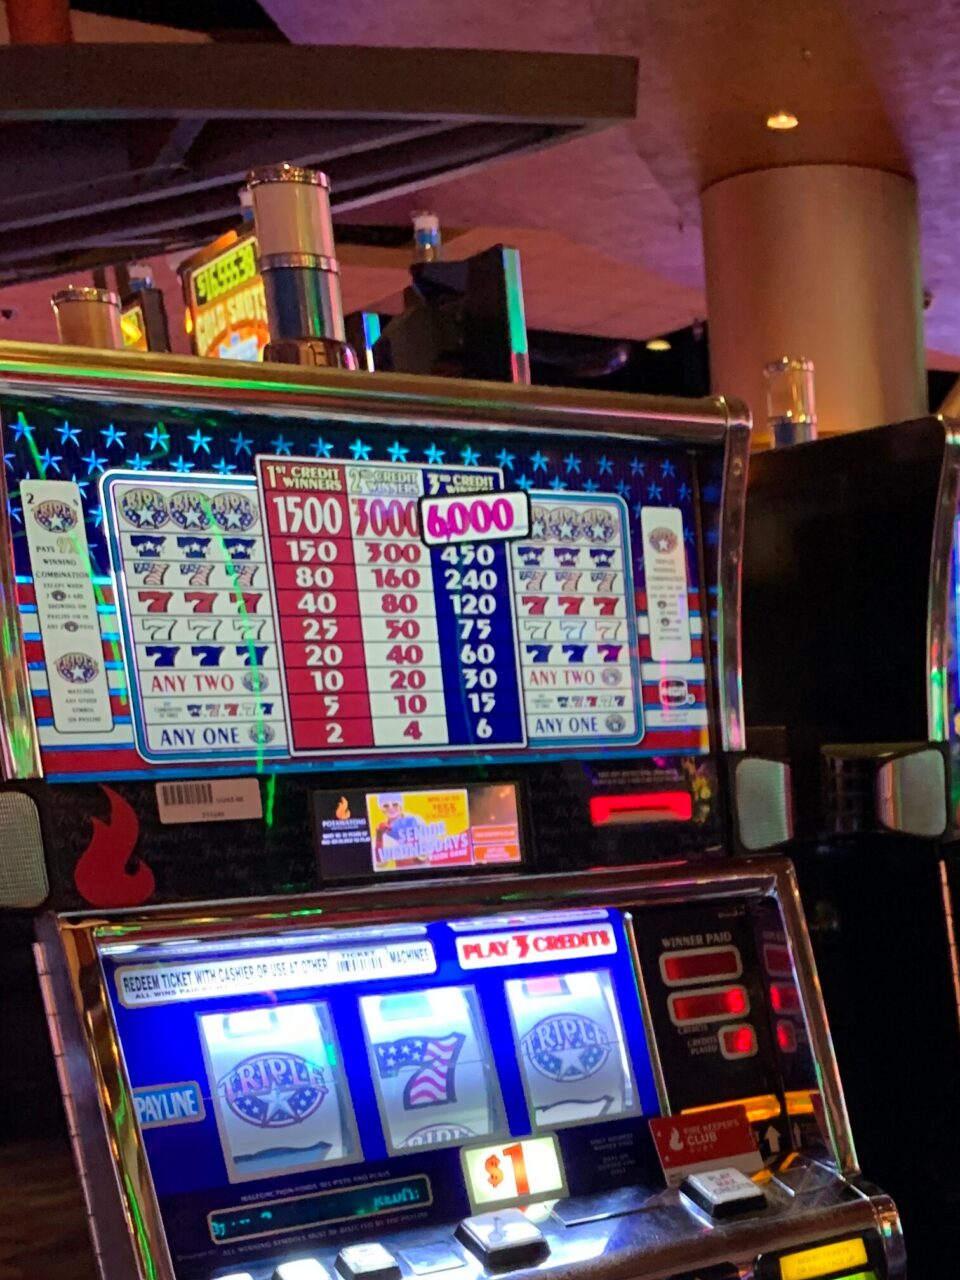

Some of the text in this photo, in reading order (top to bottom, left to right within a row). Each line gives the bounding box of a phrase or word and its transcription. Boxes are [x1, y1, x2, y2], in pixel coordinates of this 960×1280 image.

[291, 467, 339, 479] CREDIT
[373, 471, 418, 483] CREDIT
[452, 474, 494, 488] CREDIT
[283, 477, 342, 491] WINNERS
[273, 496, 342, 534] 1500
[352, 498, 421, 538] 3000
[287, 541, 338, 562] 150
[365, 543, 421, 563] 300
[441, 545, 495, 565] 450
[43, 558, 77, 566] WINNING
[296, 567, 334, 588] 80
[371, 568, 420, 589] 160
[444, 569, 498, 590] 240
[297, 592, 337, 613] 40
[381, 593, 420, 614] 80
[449, 594, 497, 614] 120
[302, 619, 338, 640] 25
[385, 619, 420, 639] 50
[458, 619, 492, 639] 75
[305, 645, 343, 666] 20
[386, 644, 424, 665] 40
[460, 644, 495, 665] 60
[151, 674, 235, 693] ANY TWO
[310, 670, 344, 692] 10
[390, 670, 426, 690] 20
[462, 669, 497, 690] 30
[529, 669, 595, 686] ANY TWO
[323, 695, 339, 717] 5
[394, 694, 427, 714] 10
[468, 693, 496, 713] 15
[326, 723, 344, 744] 2
[403, 721, 423, 740] 4
[476, 718, 493, 738] 6
[535, 716, 599, 733] ANY ONE
[161, 727, 241, 746] ANY ONE
[462, 929, 611, 961] PLAY 3 CREDITS
[661, 931, 732, 948] WINNER PAID
[389, 948, 429, 963] MACHINES
[123, 974, 160, 992] REDEEM
[161, 971, 192, 989] TICKET
[194, 970, 216, 984] WITH
[219, 965, 254, 983] CASHIER
[272, 962, 287, 976] USE
[301, 958, 328, 974] OTHER
[218, 1058, 328, 1101] TRIPLE
[138, 1089, 200, 1121] PAYLINE
[687, 1132, 718, 1146] CLUB
[484, 1143, 529, 1196] $1
